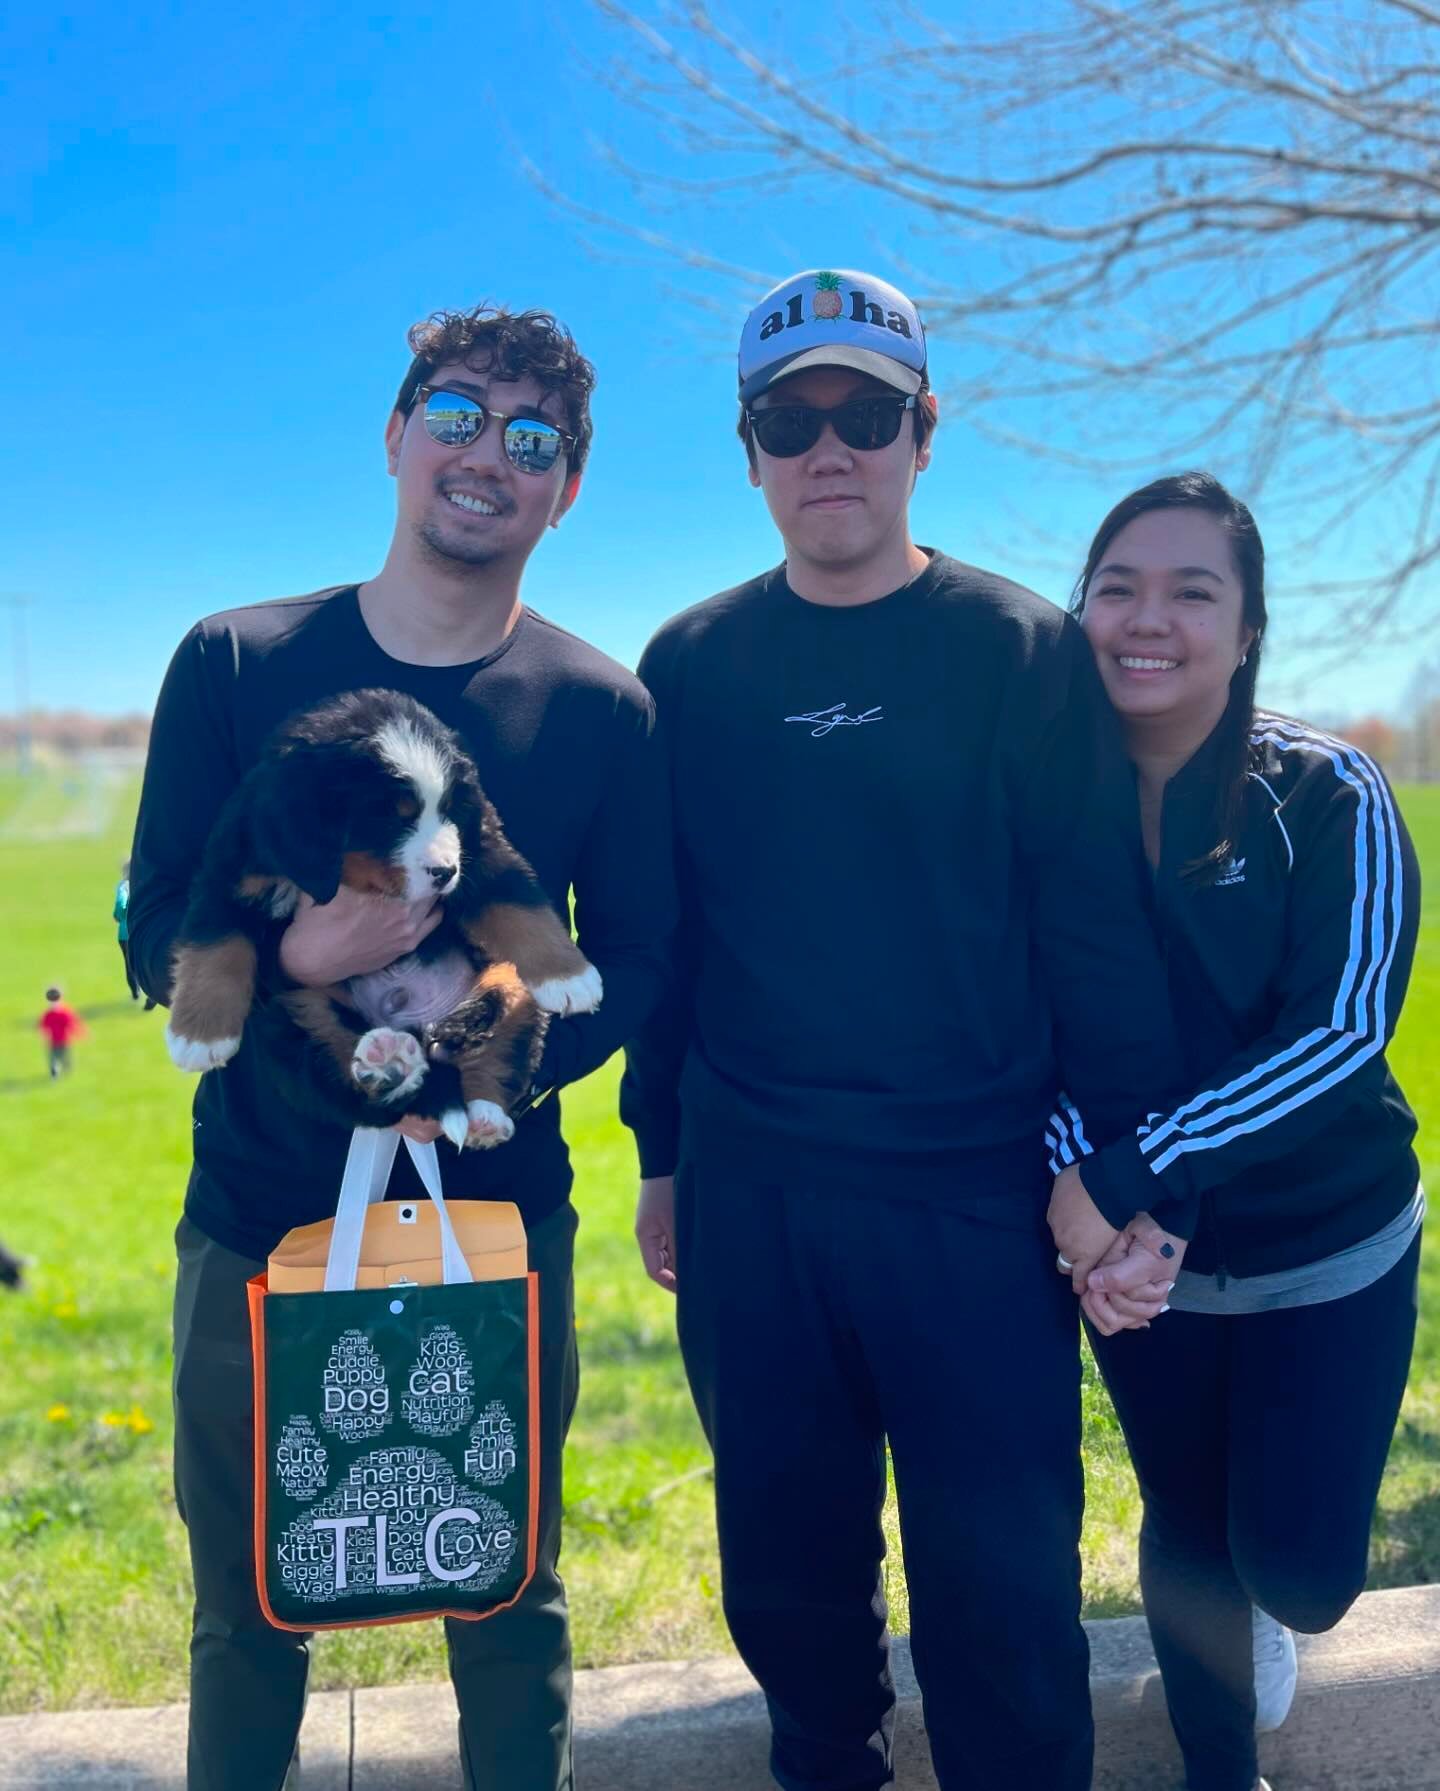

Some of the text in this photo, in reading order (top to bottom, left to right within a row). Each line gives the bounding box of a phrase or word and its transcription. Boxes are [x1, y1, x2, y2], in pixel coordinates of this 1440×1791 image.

[338, 1336, 369, 1346] Smile
[420, 1340, 460, 1357] Kids
[331, 1344, 374, 1355] Energy
[328, 1355, 379, 1369] Cuddle
[417, 1353, 467, 1370] Woof
[323, 1366, 385, 1385] Puppy
[409, 1367, 469, 1396] Cat
[324, 1387, 389, 1414] Dog
[402, 1395, 471, 1411] Nutrition
[332, 1415, 384, 1430] Happy
[408, 1407, 464, 1424] Playful
[478, 1417, 512, 1435] TLC
[339, 1430, 370, 1441] Woof
[471, 1433, 515, 1450] Smile
[277, 1446, 328, 1463] Cute
[369, 1447, 426, 1464] Family
[464, 1449, 516, 1474] Fun
[276, 1463, 330, 1478] Meow
[349, 1463, 437, 1485] Energy
[281, 1477, 328, 1488] Natural
[435, 1474, 458, 1485] Cat
[344, 1484, 455, 1511] Healthy
[310, 1507, 344, 1518] Kitty
[389, 1508, 427, 1526] Joy
[281, 1531, 334, 1544] Treats
[346, 1535, 376, 1547] Kids
[388, 1531, 423, 1546] Dog
[440, 1529, 512, 1557] Love
[277, 1544, 335, 1563] Kitty
[313, 1508, 481, 1590] TLC
[391, 1546, 423, 1562] Cat
[346, 1551, 376, 1566] Fun
[387, 1559, 426, 1573] Love
[282, 1564, 334, 1581] Giggle
[348, 1571, 376, 1584] Joy
[293, 1580, 334, 1595] Wag
